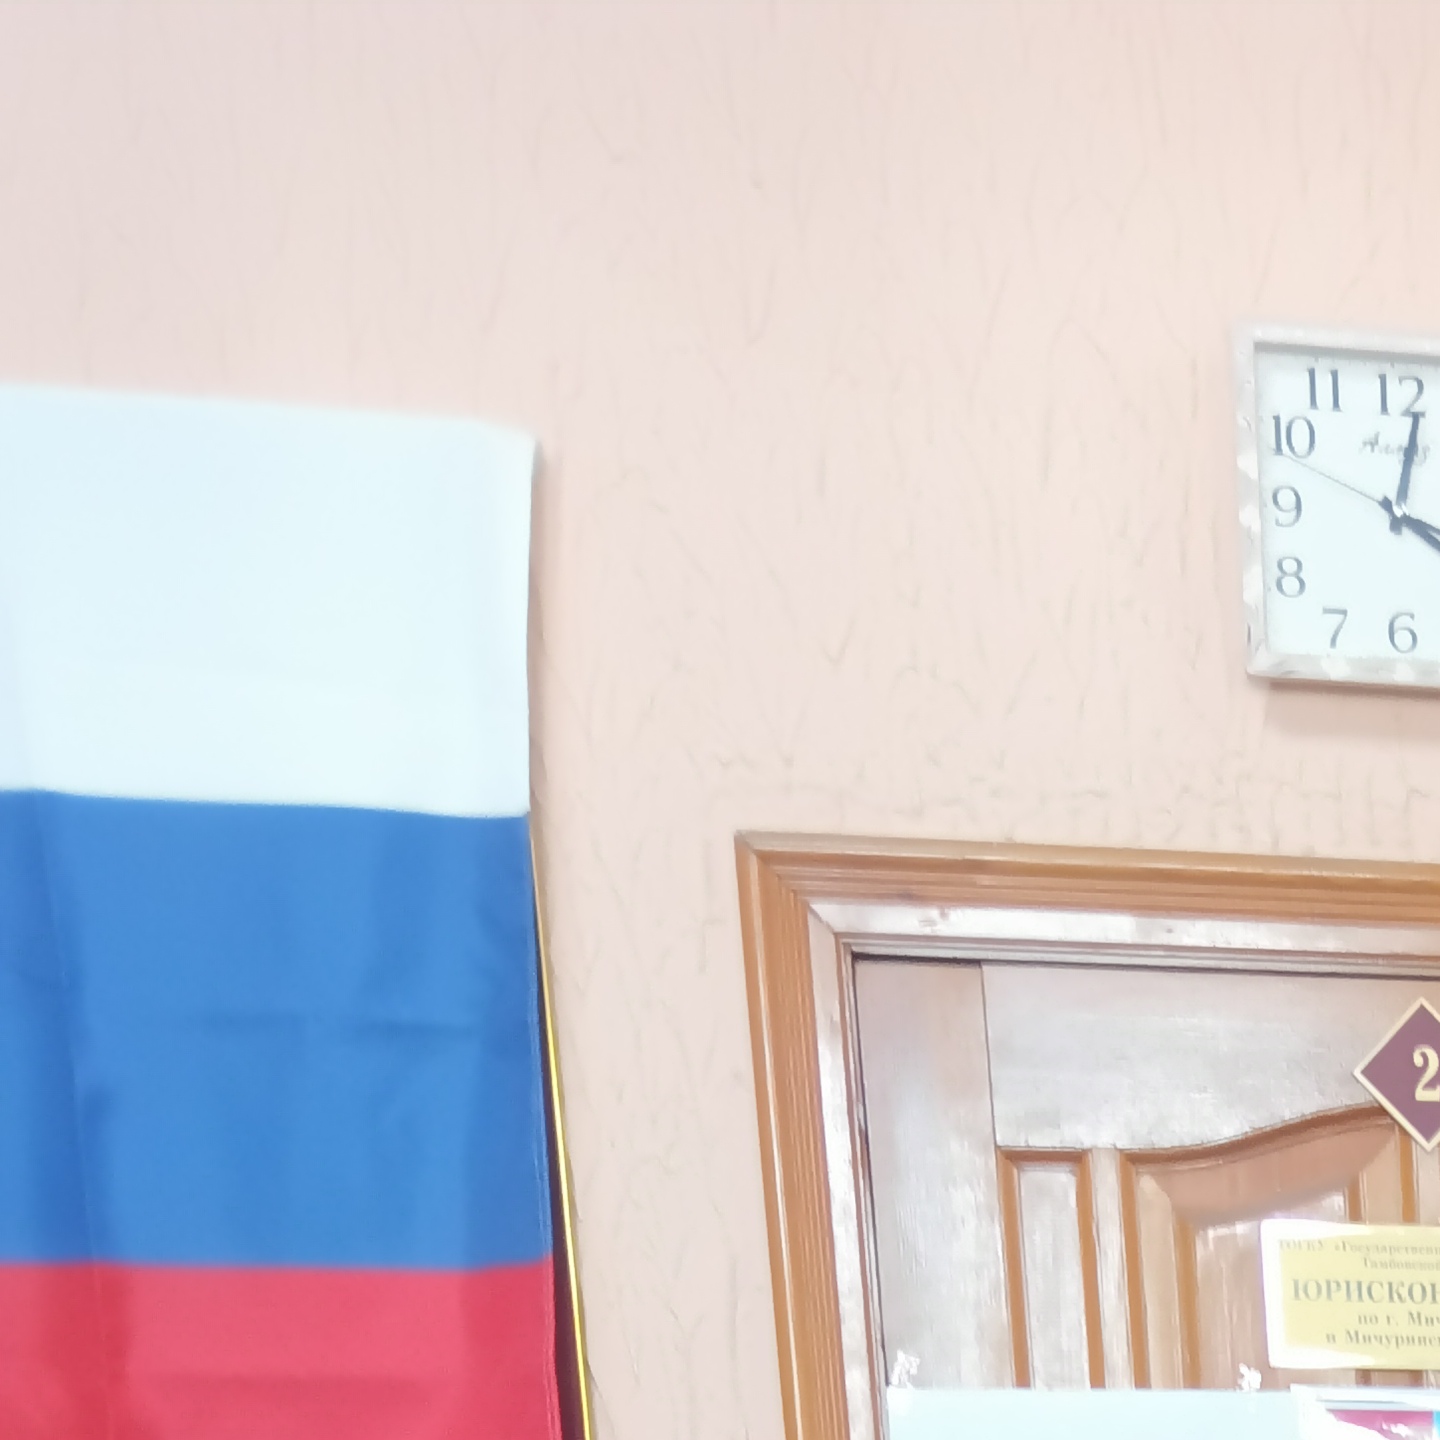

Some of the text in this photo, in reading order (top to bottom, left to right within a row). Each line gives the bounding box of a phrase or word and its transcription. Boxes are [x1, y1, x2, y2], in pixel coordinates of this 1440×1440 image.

[1307, 367, 1342, 412] 11
[1377, 373, 1427, 418] 12
[1272, 414, 1316, 458] 10
[1271, 485, 1303, 528] 9
[1275, 556, 1307, 599] 8
[1321, 607, 1348, 649] 7
[1387, 612, 1419, 654] 6
